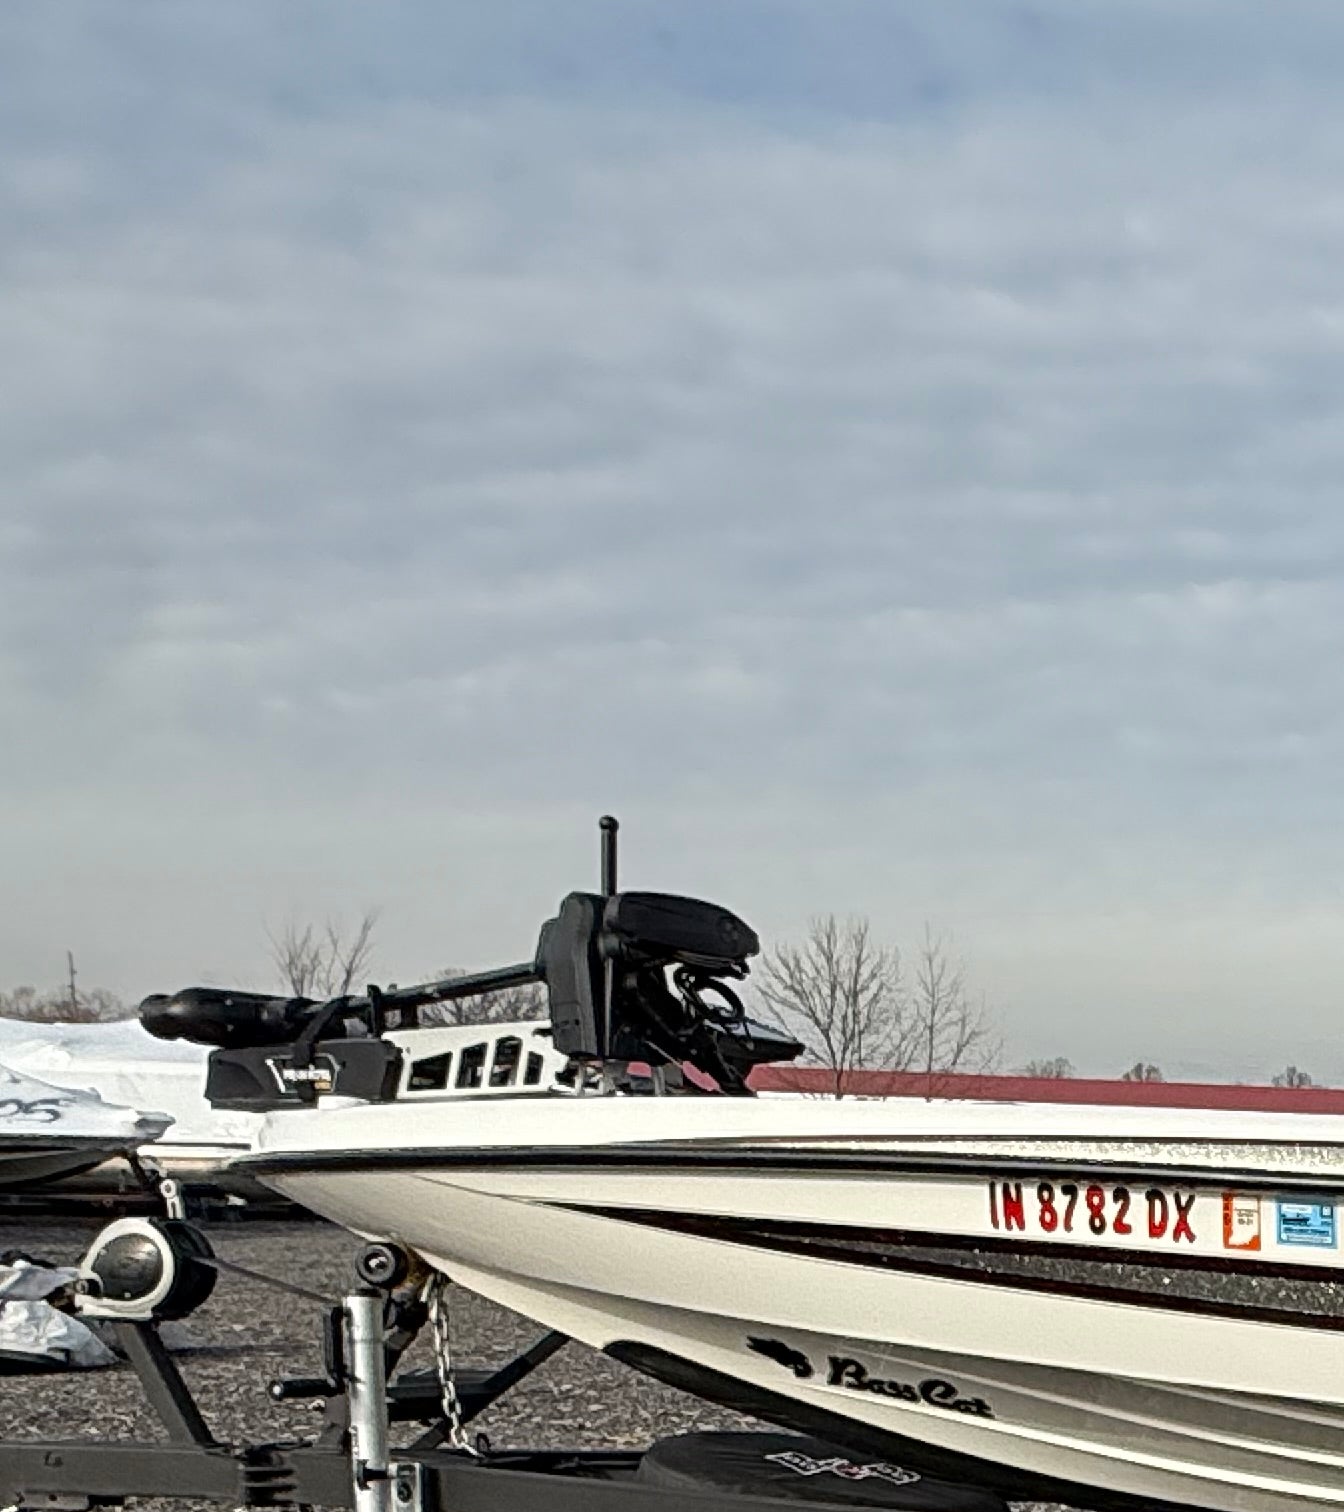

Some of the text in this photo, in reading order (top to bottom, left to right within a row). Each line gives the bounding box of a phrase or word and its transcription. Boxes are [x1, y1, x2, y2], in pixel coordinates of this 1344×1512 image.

[988, 1180, 1026, 1231] IN
[1036, 1182, 1132, 1235] 8782
[1144, 1188, 1197, 1244] DX
[827, 1355, 996, 1420] Bass Cat
